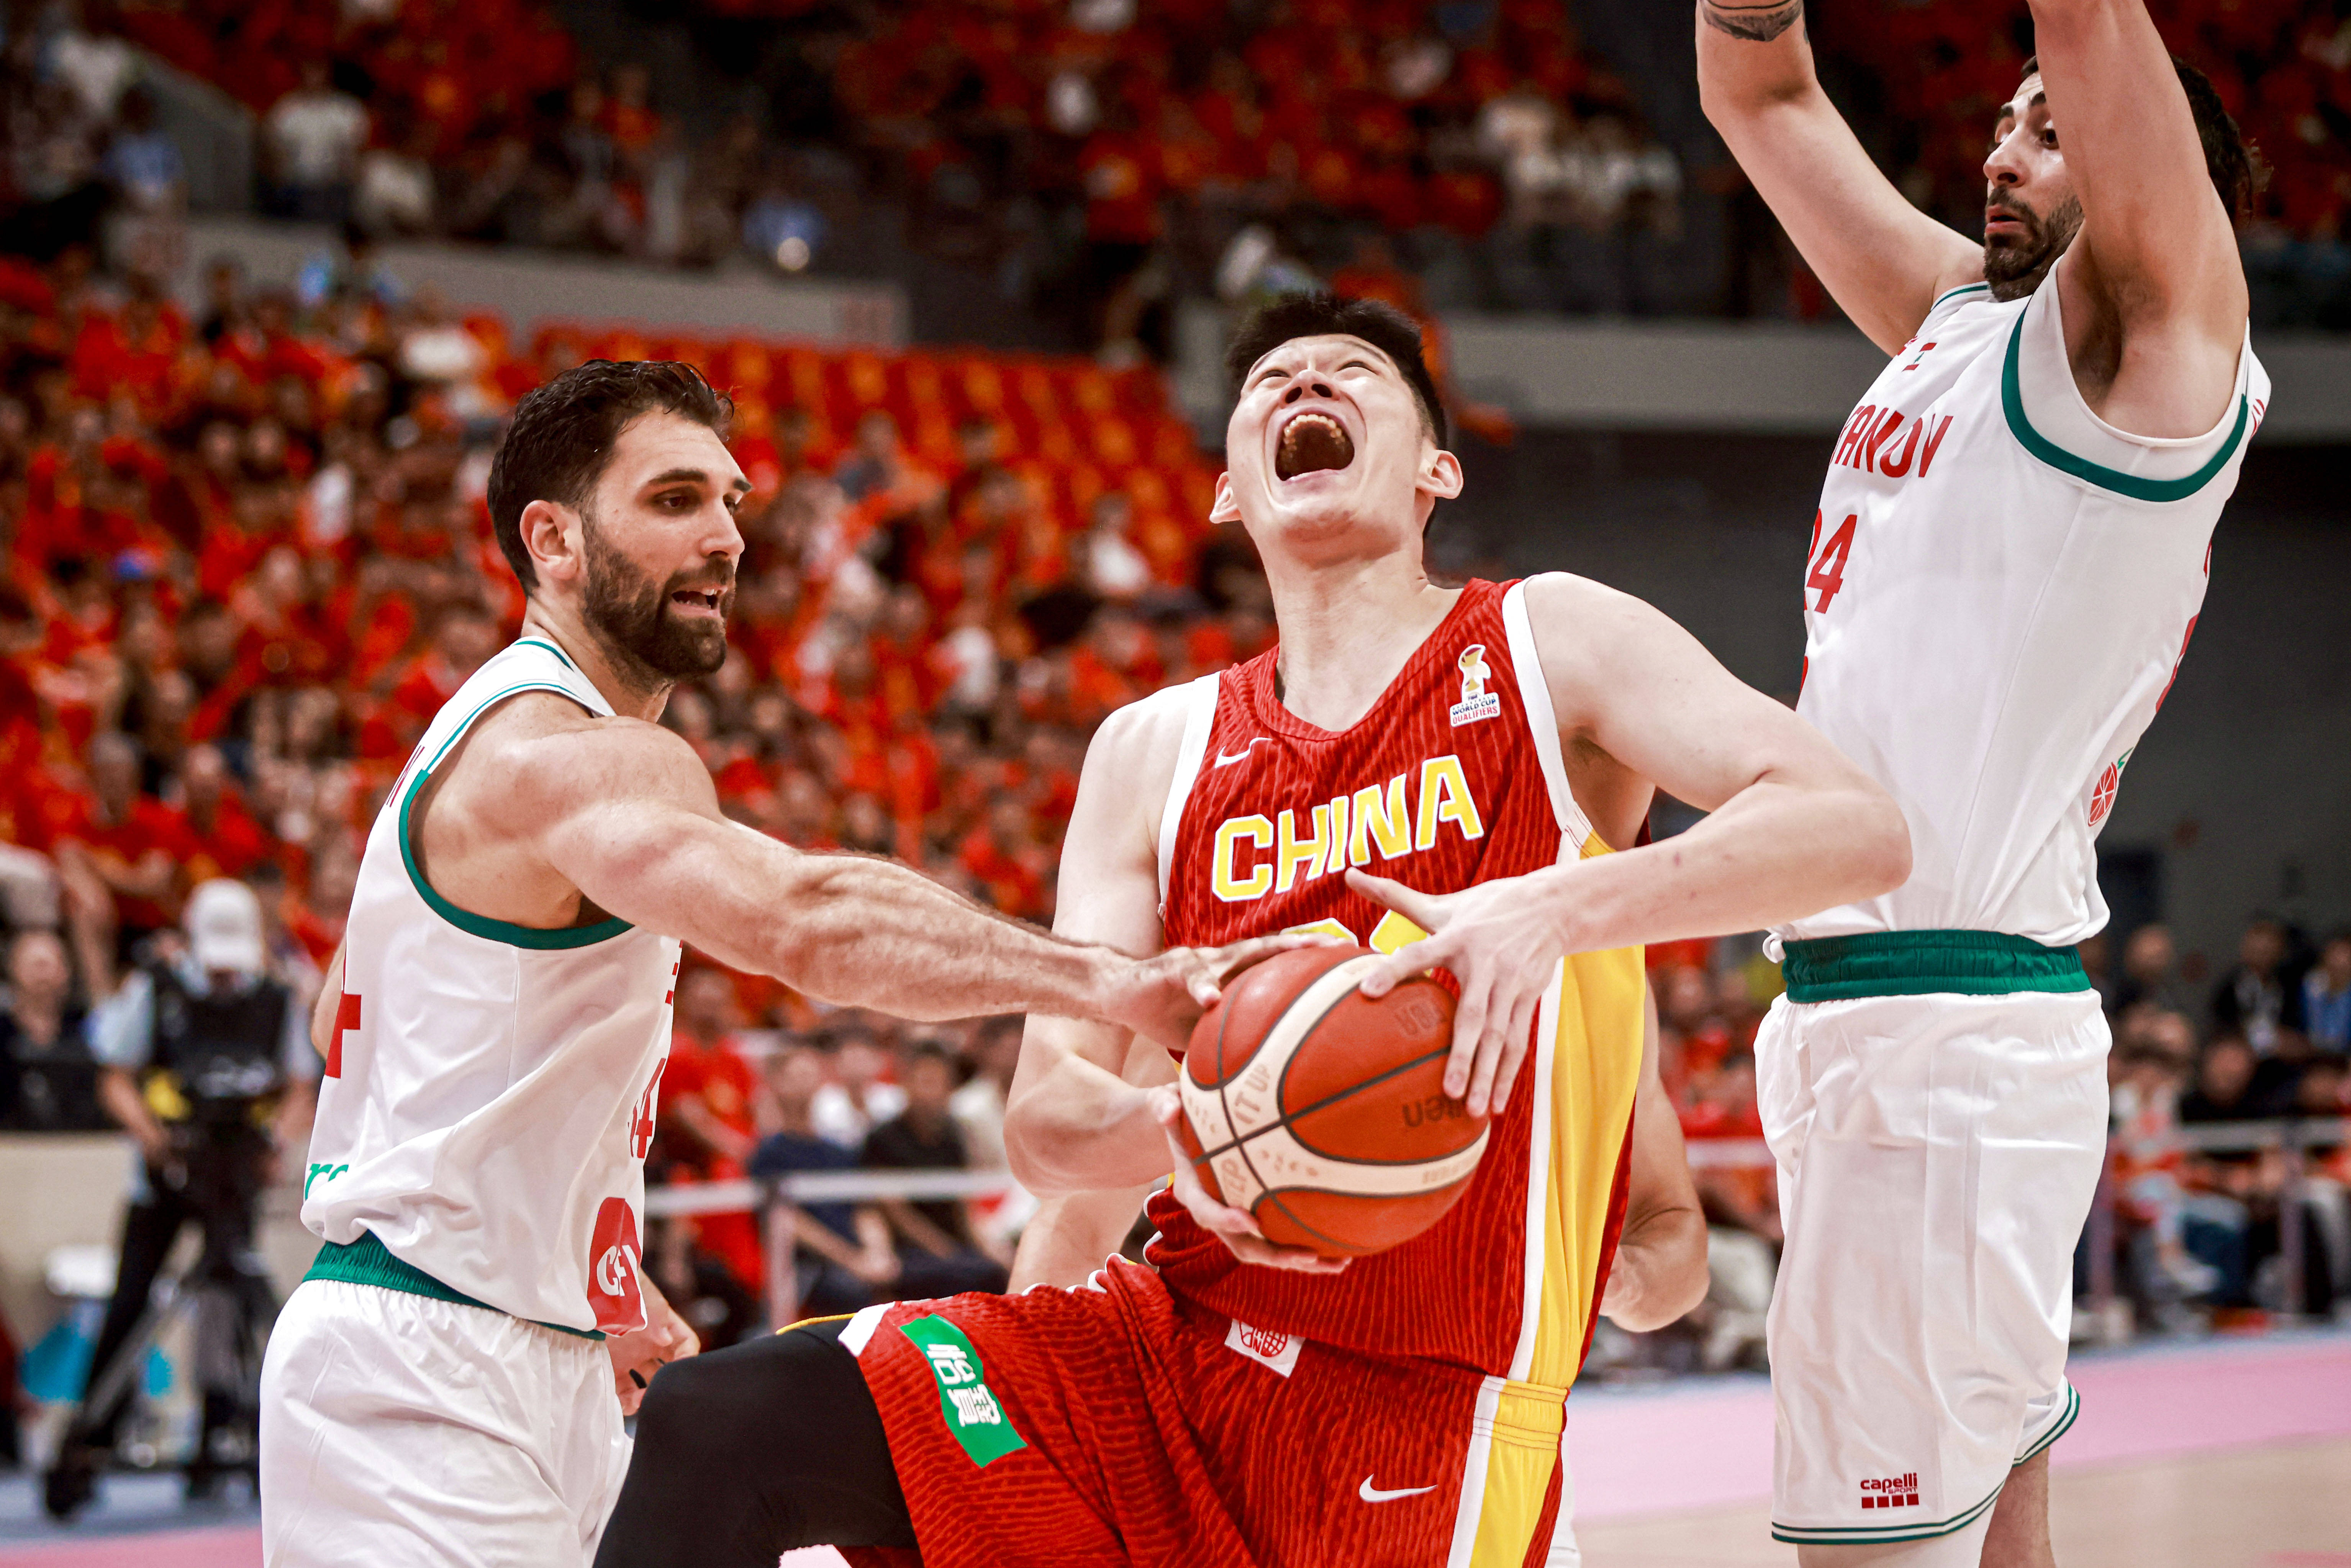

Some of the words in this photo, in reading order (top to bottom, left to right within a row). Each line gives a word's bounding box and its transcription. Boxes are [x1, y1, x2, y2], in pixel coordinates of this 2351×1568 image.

[1453, 703, 1479, 715] WORLD
[1481, 698, 1496, 706] CUP
[1453, 706, 1497, 724] QUALIFIERS
[1212, 754, 1484, 902] CHINA
[927, 1344, 1001, 1427] 怡寶
[1861, 1472, 1917, 1493] capelli
